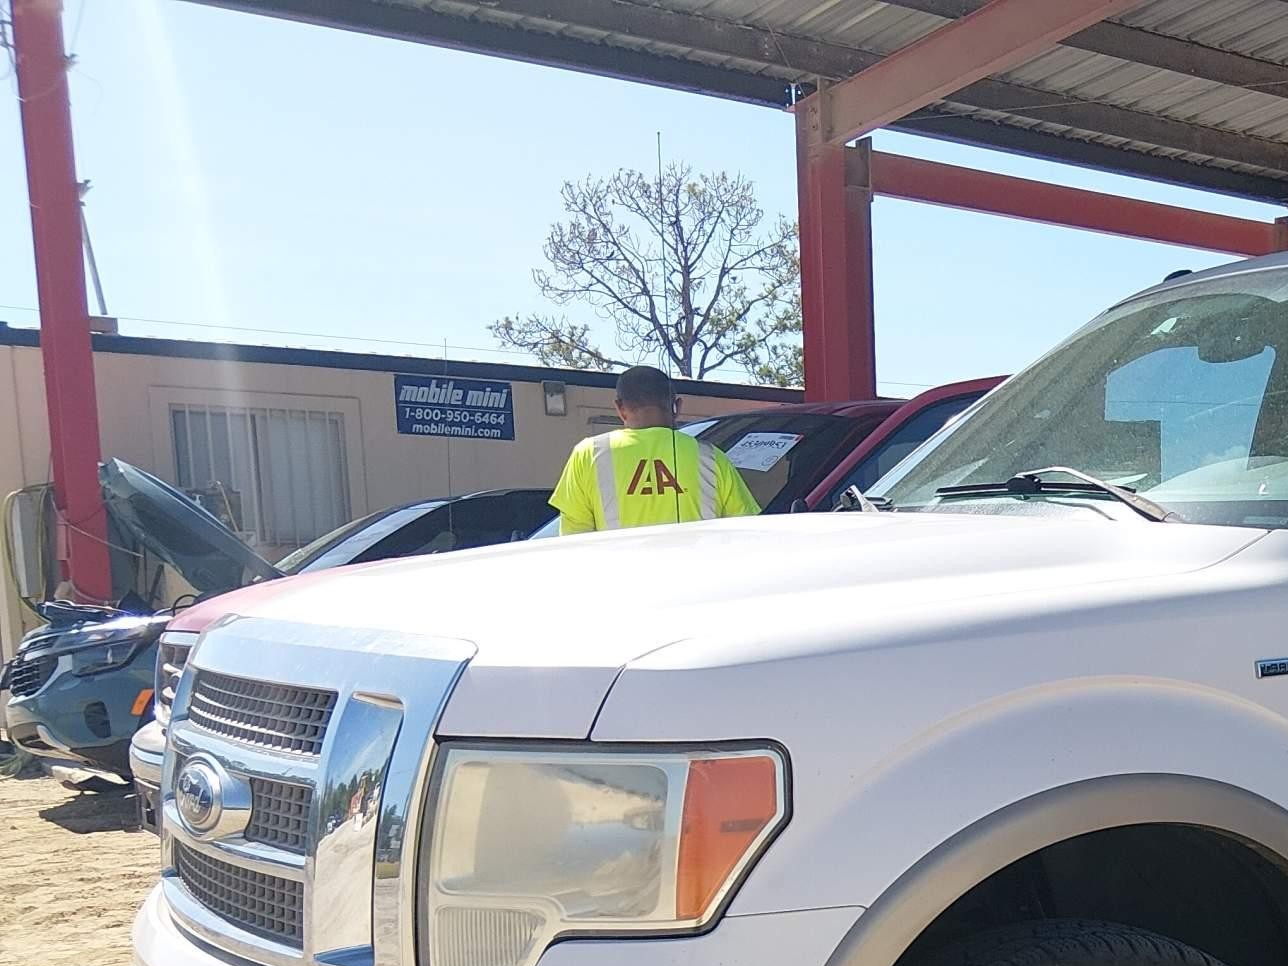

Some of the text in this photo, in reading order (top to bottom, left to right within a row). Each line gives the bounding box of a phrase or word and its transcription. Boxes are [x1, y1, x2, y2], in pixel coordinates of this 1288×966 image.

[400, 380, 508, 408] mobile mini
[404, 407, 505, 425] 1-800-950-6464
[412, 423, 501, 437] mobilemini.com
